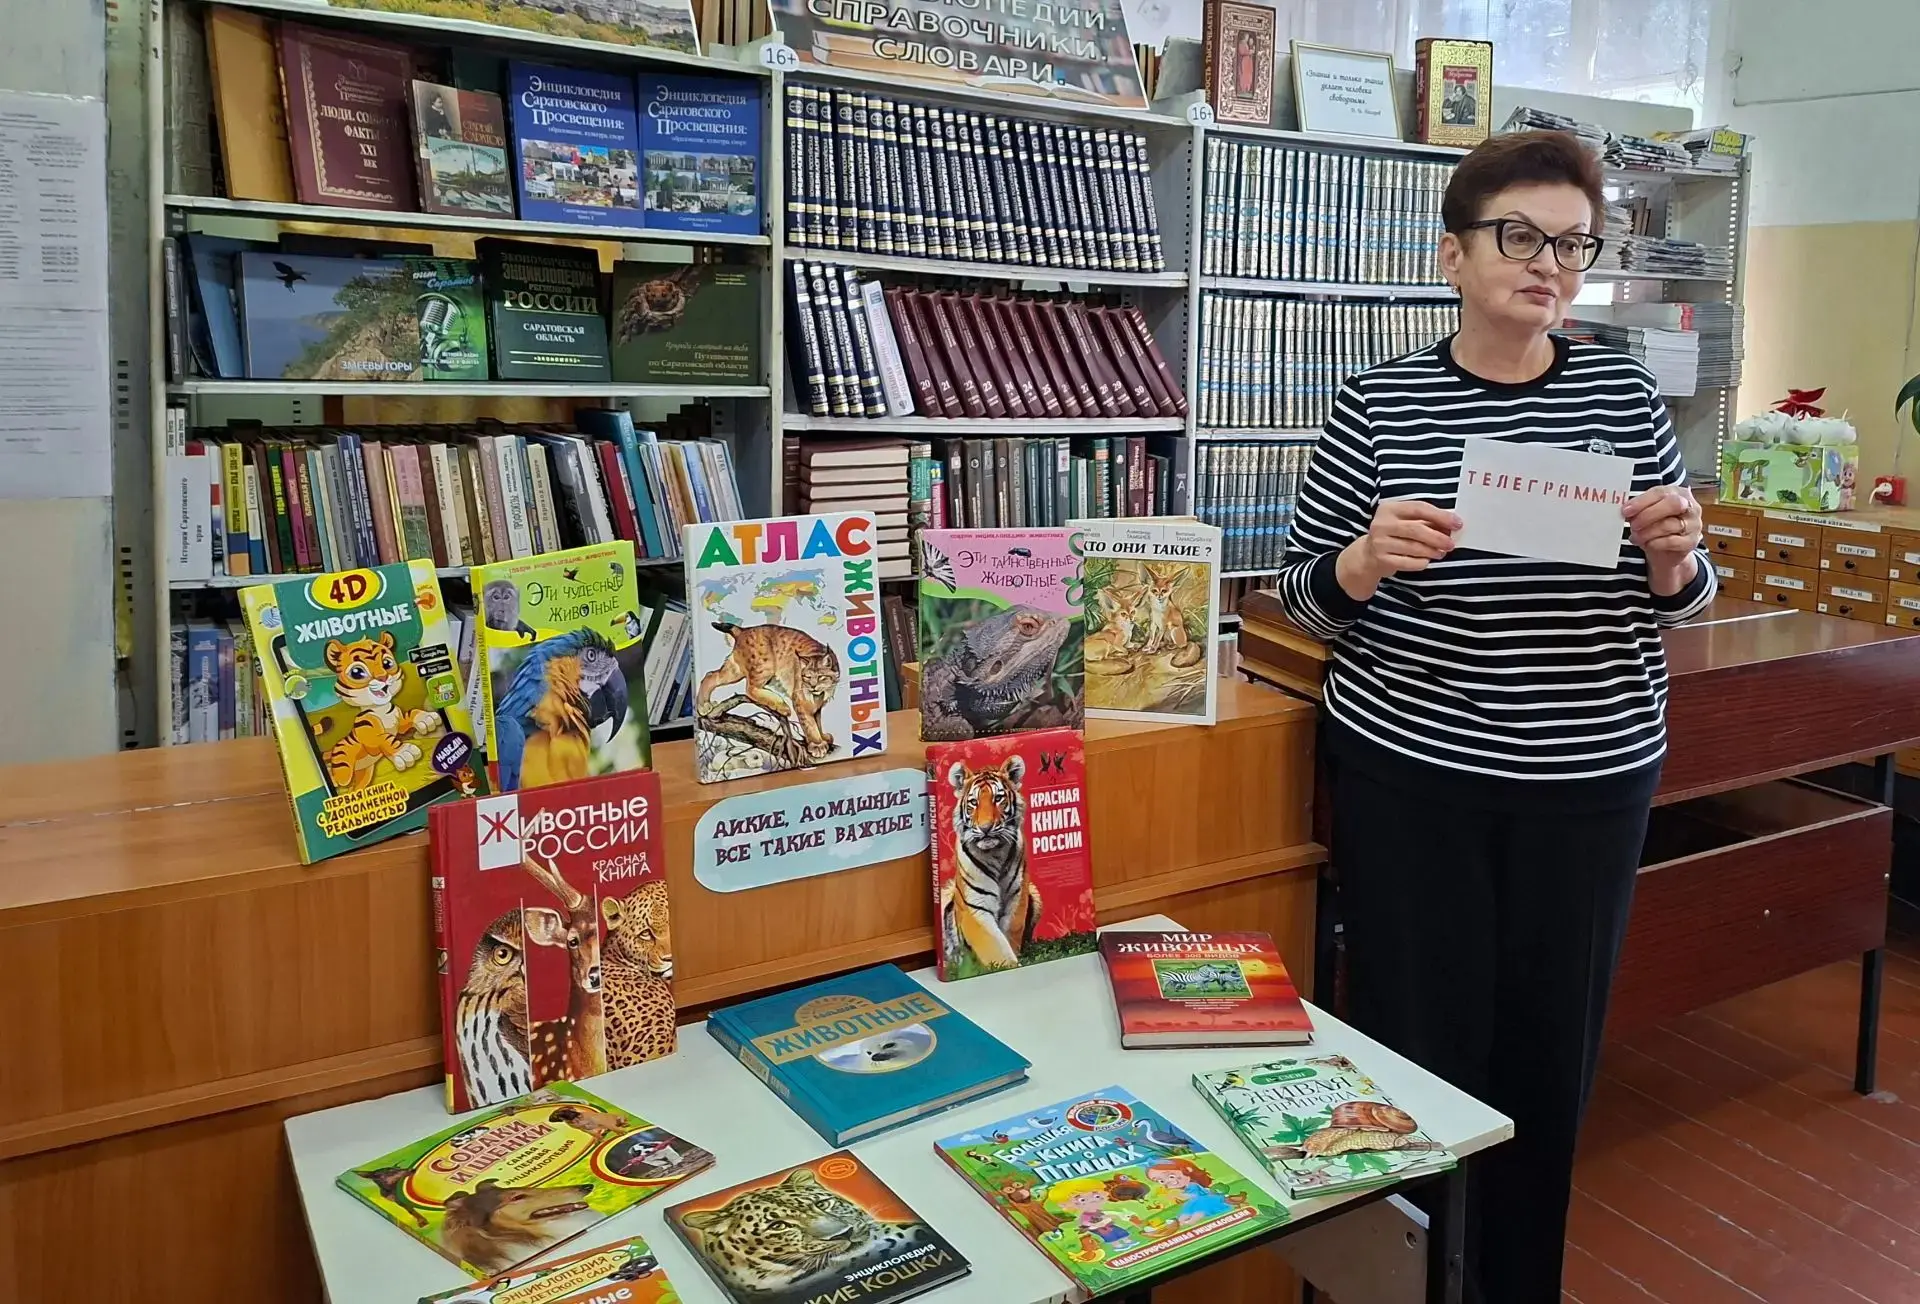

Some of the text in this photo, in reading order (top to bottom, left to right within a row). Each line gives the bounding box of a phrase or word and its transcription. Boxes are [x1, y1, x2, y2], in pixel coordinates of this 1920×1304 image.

[765, 46, 797, 66] 16+
[529, 75, 621, 101] Энциклопедия
[656, 85, 747, 106] Энциклопедия
[522, 92, 607, 114] Саратовского
[648, 101, 731, 119] Саратовского
[1192, 106, 1213, 121] 16+
[532, 109, 625, 131] Просвещения:
[657, 118, 748, 135] Просвещения:
[975, 231, 984, 241] 17
[503, 290, 597, 314] РОССИИ
[523, 323, 585, 335] САРАТОВСКАЯ
[536, 334, 575, 344] ОБЛАСТЬ
[340, 360, 382, 372] ЗМЕЕВЫ
[384, 361, 413, 372] ГОРЫ
[920, 379, 931, 391] 20
[941, 380, 950, 391] 21
[983, 381, 992, 392] 23
[1468, 470, 1630, 506] ТЕЛЕГРАММЫ
[696, 516, 872, 569] АТЛАС
[1112, 542, 1146, 554] ОНИ
[1152, 543, 1201, 557] ТАКИЕ
[957, 550, 1074, 569] ЭТИ ТАИНСТВЕННЫЕ
[330, 574, 367, 603] 4D
[981, 570, 1057, 587] ЖИВОТНЫЕ
[526, 575, 624, 606] ЭТИ ЧУДЕСНЫЕ
[548, 596, 620, 623] ЖИВОТНЫЕ
[294, 603, 412, 643] ЖИВОТНЫЕ
[843, 559, 883, 756] ЖИВОТНЫХ
[435, 736, 465, 762] НАВЕДИ
[447, 745, 468, 765] ОЖИВИ
[318, 791, 407, 824] С ДОПОЛНЕННОЙ
[325, 784, 394, 810] ПЕРВАЯ КНИГА
[1030, 787, 1079, 808] КРАСНАЯ
[326, 803, 405, 835] РЕАЛЬНОСТЬЮ
[714, 811, 790, 839] ДИКИЕ,
[1031, 807, 1081, 833] КНИГА
[521, 818, 650, 861] РОССИИ
[715, 844, 751, 867] ВСЕ
[760, 829, 825, 858] ТАКИЕ
[834, 812, 913, 845] ВАЖНЫЕ
[928, 795, 940, 904] КРАСНАЯ КНИГА РОССИИ
[1032, 831, 1083, 854] РОССИИ
[592, 852, 647, 872] КРАСНАЯ
[599, 863, 652, 884] КНИГА
[1118, 943, 1264, 953] ЖИВОТНЫХ
[1161, 933, 1213, 943] МИР
[764, 997, 935, 1057] ЖИВОТНЫЕ
[1242, 1076, 1354, 1105] ЖИВАЯ
[1266, 1090, 1359, 1113] ПРИРОДА
[449, 1123, 553, 1184] И ЩЕНКИ
[993, 1124, 1074, 1164] БОЛЬШАЯ
[1036, 1135, 1113, 1163] КНИГА
[1082, 1151, 1095, 1159] О
[503, 1139, 576, 1186] ЭНЦИКЛОПЕДИЯ
[506, 1146, 539, 1166] САМАЯ
[514, 1148, 552, 1171] ПЕРВАЯ
[1034, 1144, 1145, 1183] ПТИЦАХ
[1111, 1209, 1251, 1268] ИЛЛЮСТРИРОВАННАЯ ЭНЦИКЛОПЕДИЯ
[587, 1263, 615, 1280] САДА
[843, 1243, 936, 1282] ЭНЦИКЛОПЕДИЯ
[860, 1248, 953, 1293] КОШКИ
[501, 1255, 609, 1304] ЭНЦИКЛОПЕДИЯ
